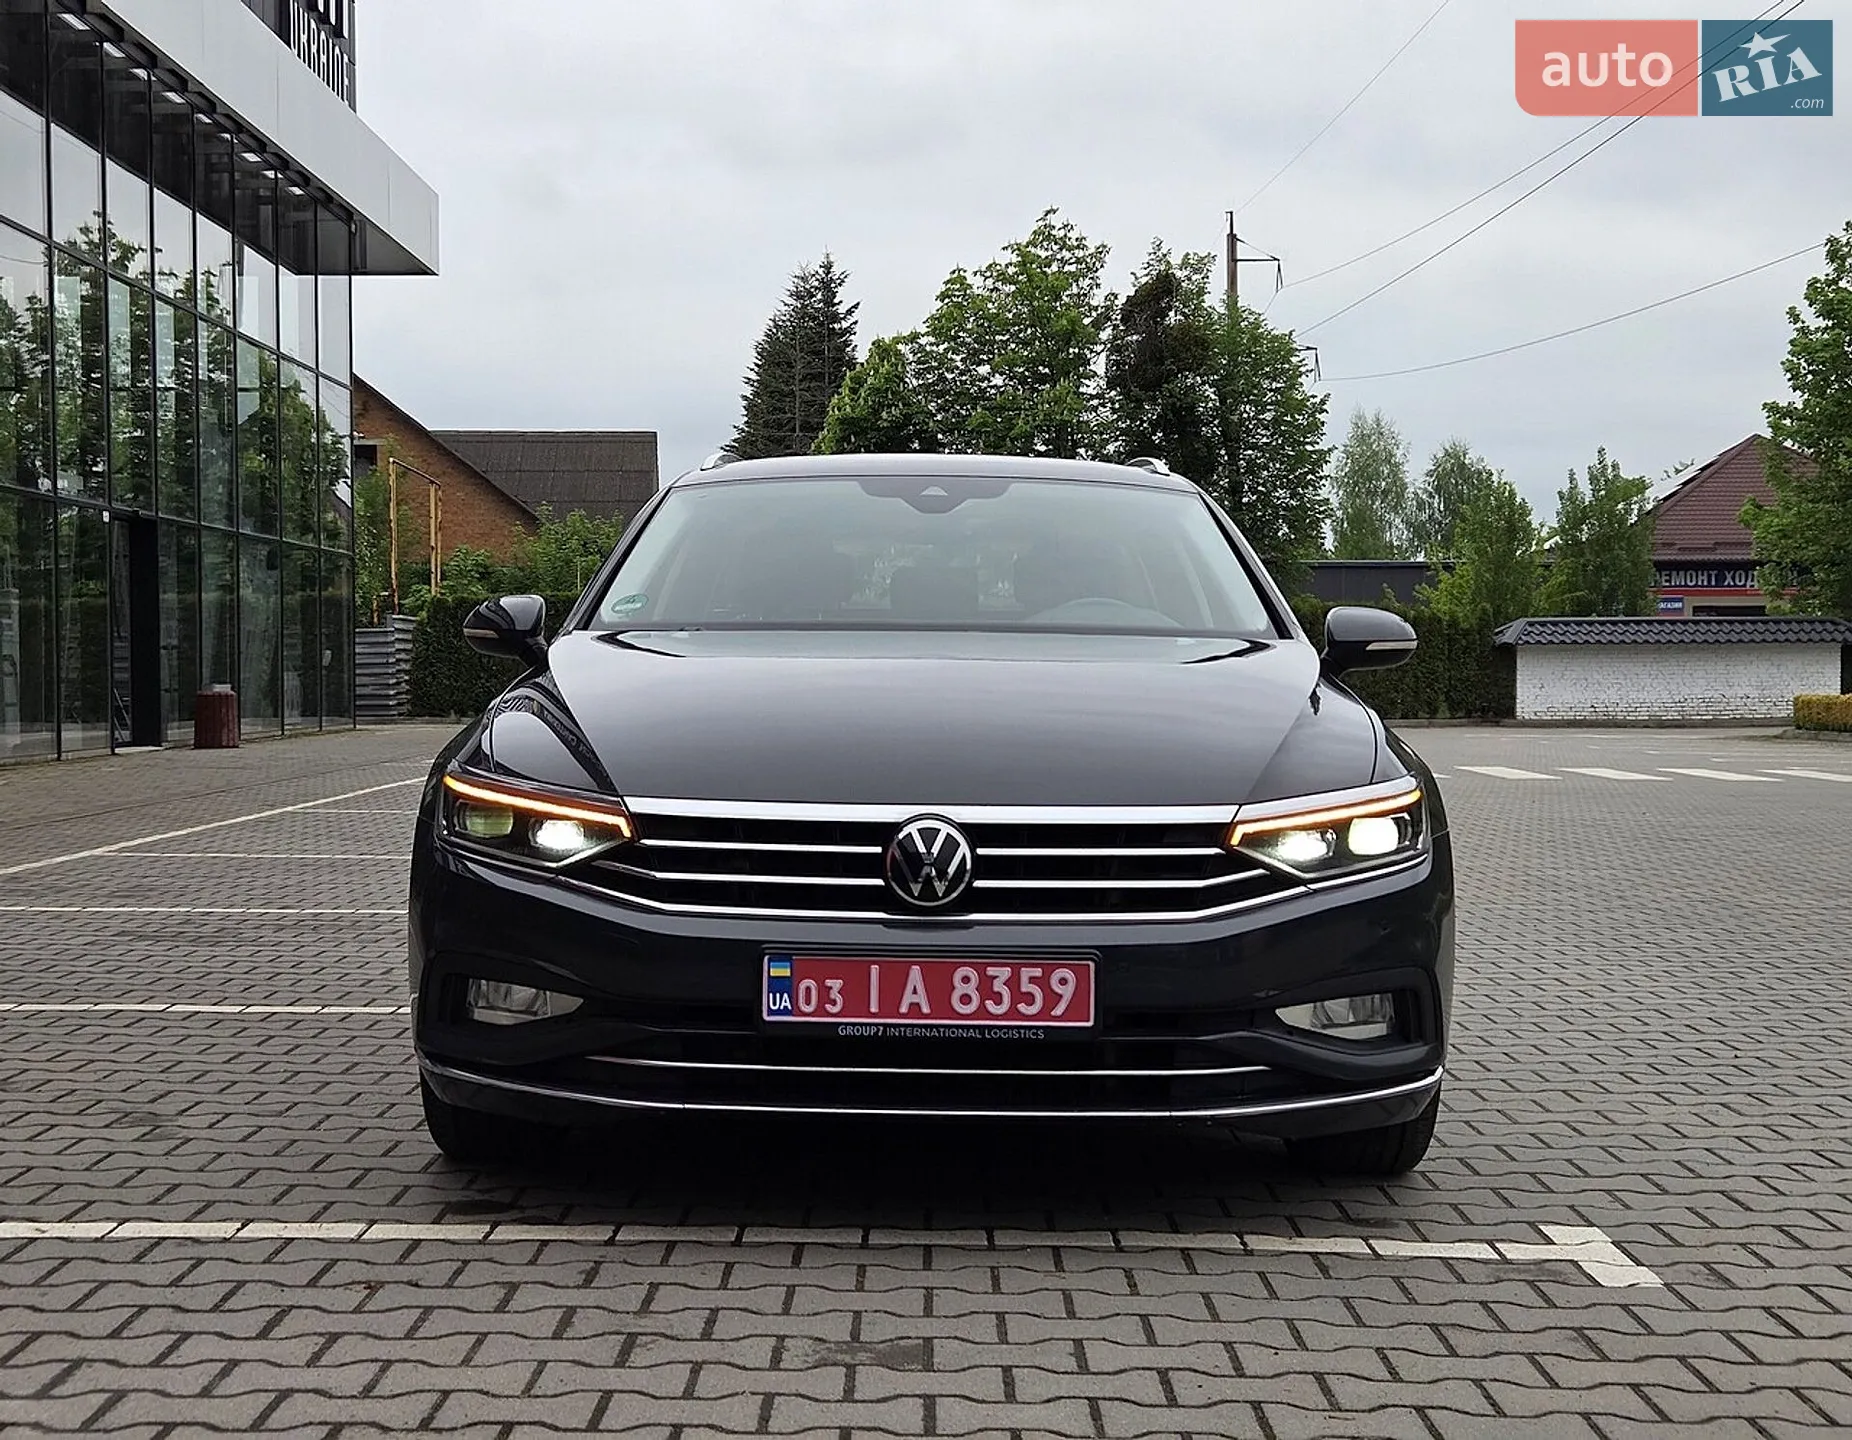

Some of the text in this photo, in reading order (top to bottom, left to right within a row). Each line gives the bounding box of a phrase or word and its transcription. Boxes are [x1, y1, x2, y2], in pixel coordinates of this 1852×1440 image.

[290, 0, 349, 105] UKRAINE
[768, 992, 792, 1011] UA
[797, 964, 1077, 1017] 03 IA 8359
[837, 1024, 1045, 1040] GROUP7 INTERNATIONAL LOGISTICS
